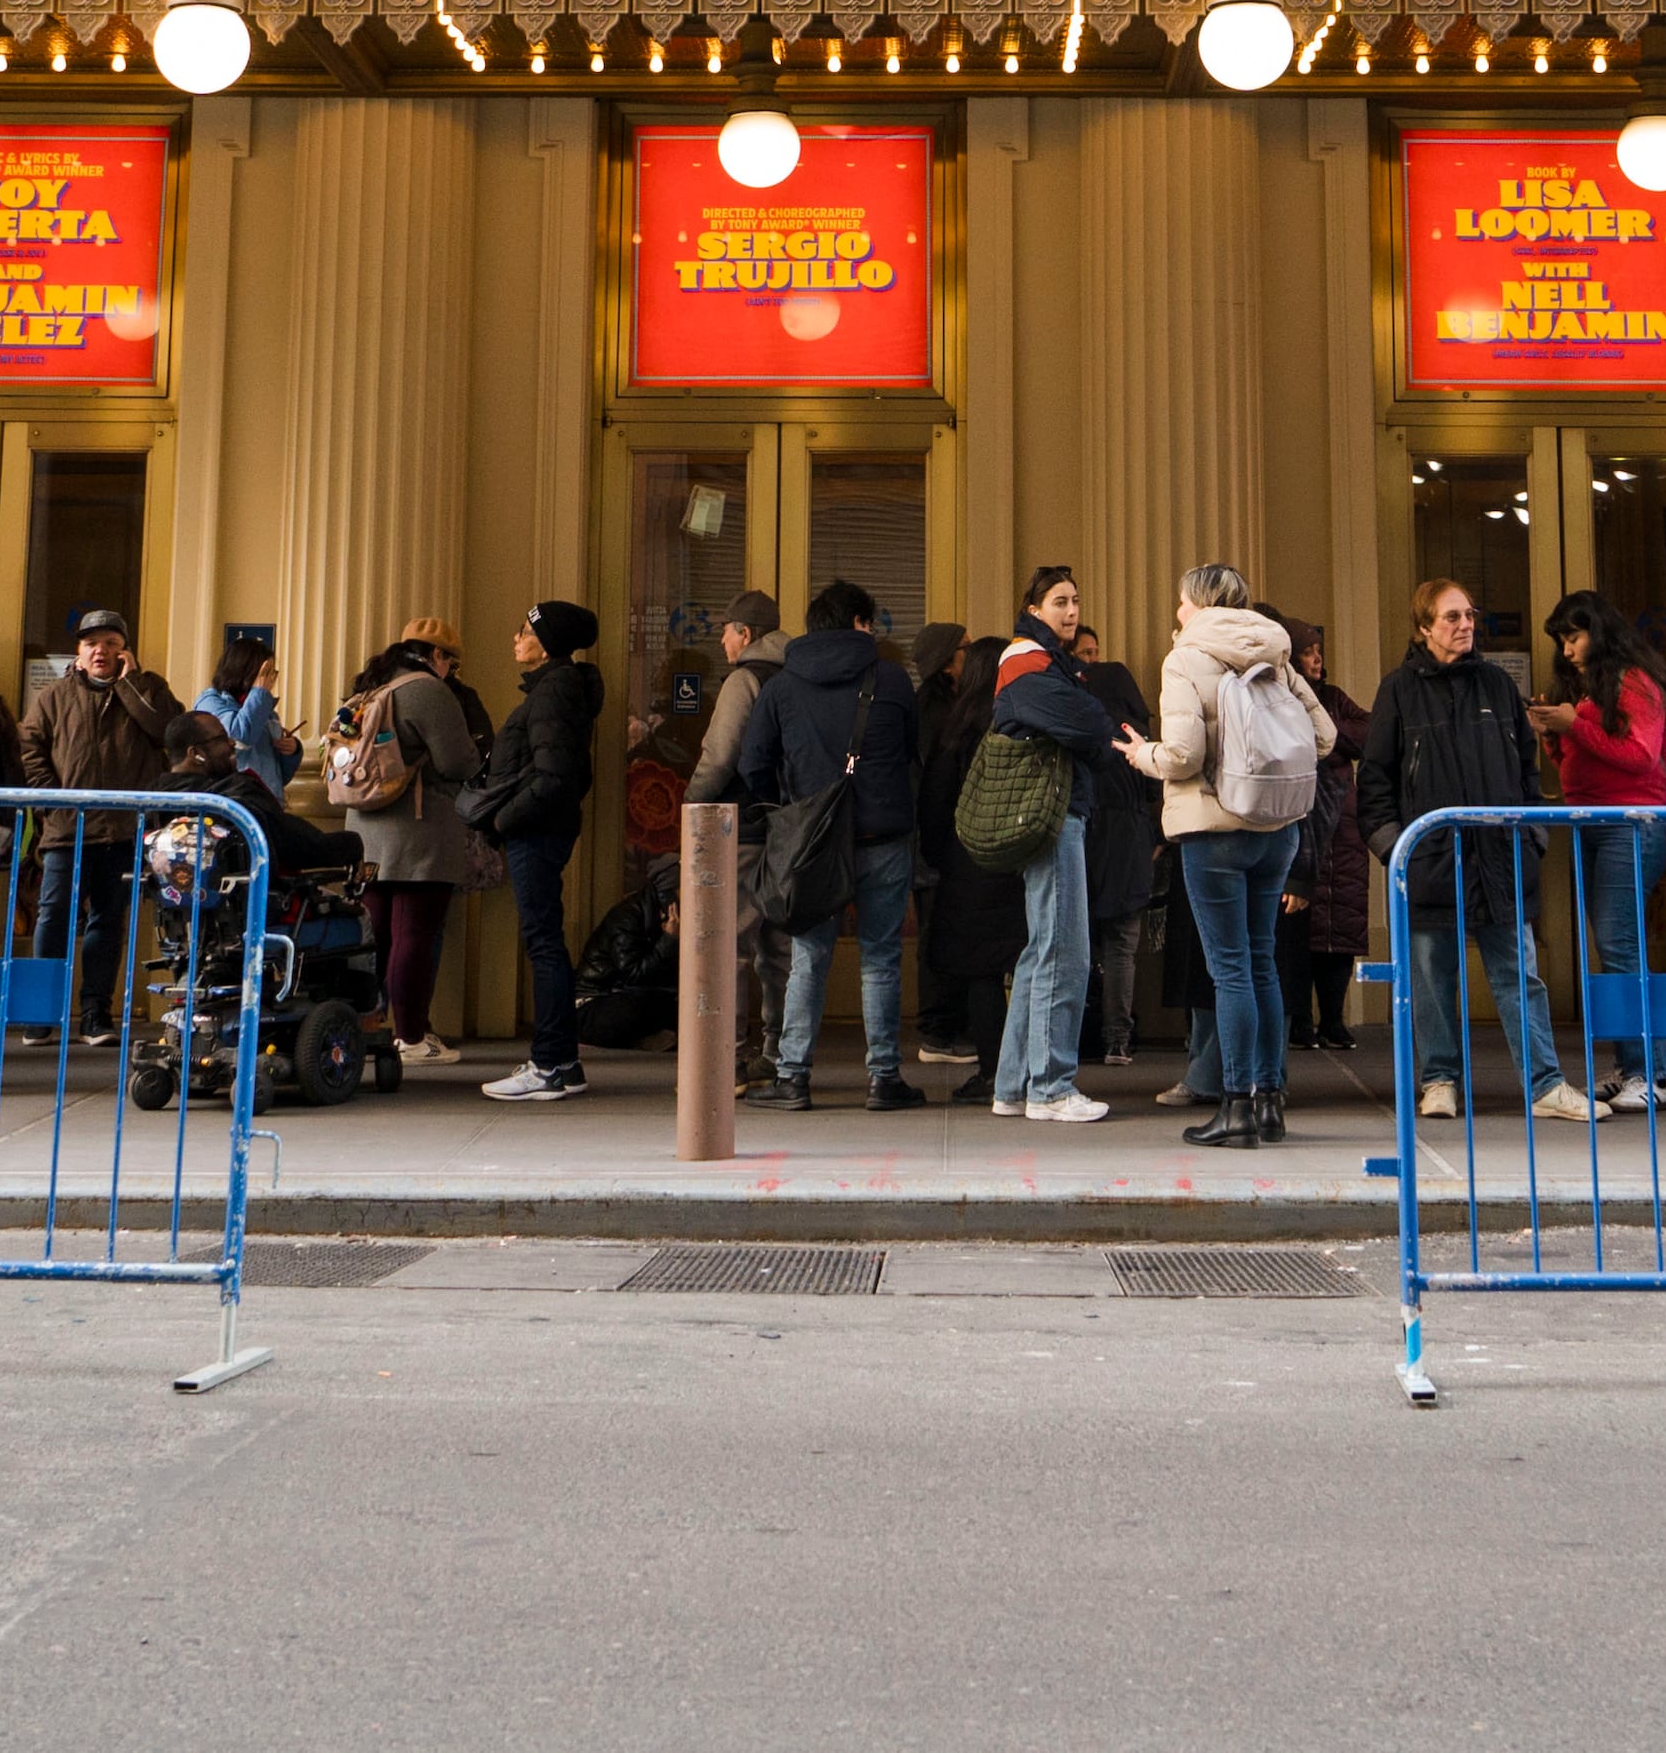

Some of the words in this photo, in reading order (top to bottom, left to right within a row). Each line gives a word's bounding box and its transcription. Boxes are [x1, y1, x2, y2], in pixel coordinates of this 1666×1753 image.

[21, 153, 60, 164] LYRICS
[64, 153, 81, 164] BY
[4, 165, 49, 176] AWARD
[53, 166, 104, 177] WINNER
[1527, 167, 1557, 178] BOOK
[1561, 167, 1576, 178] BY
[1499, 179, 1609, 211] LISA
[702, 208, 756, 219] DIRECTED
[758, 208, 767, 218] &
[769, 208, 865, 219] CHOREOGRAPHED
[710, 219, 724, 230] BY
[728, 219, 758, 230] TONY
[812, 219, 861, 230] WINNER
[1454, 209, 1657, 242] LOOMER
[697, 231, 873, 262] SERGIO
[674, 260, 897, 293] TRUJILLO
[1521, 262, 1590, 279] WITH
[1501, 281, 1614, 312] NELL
